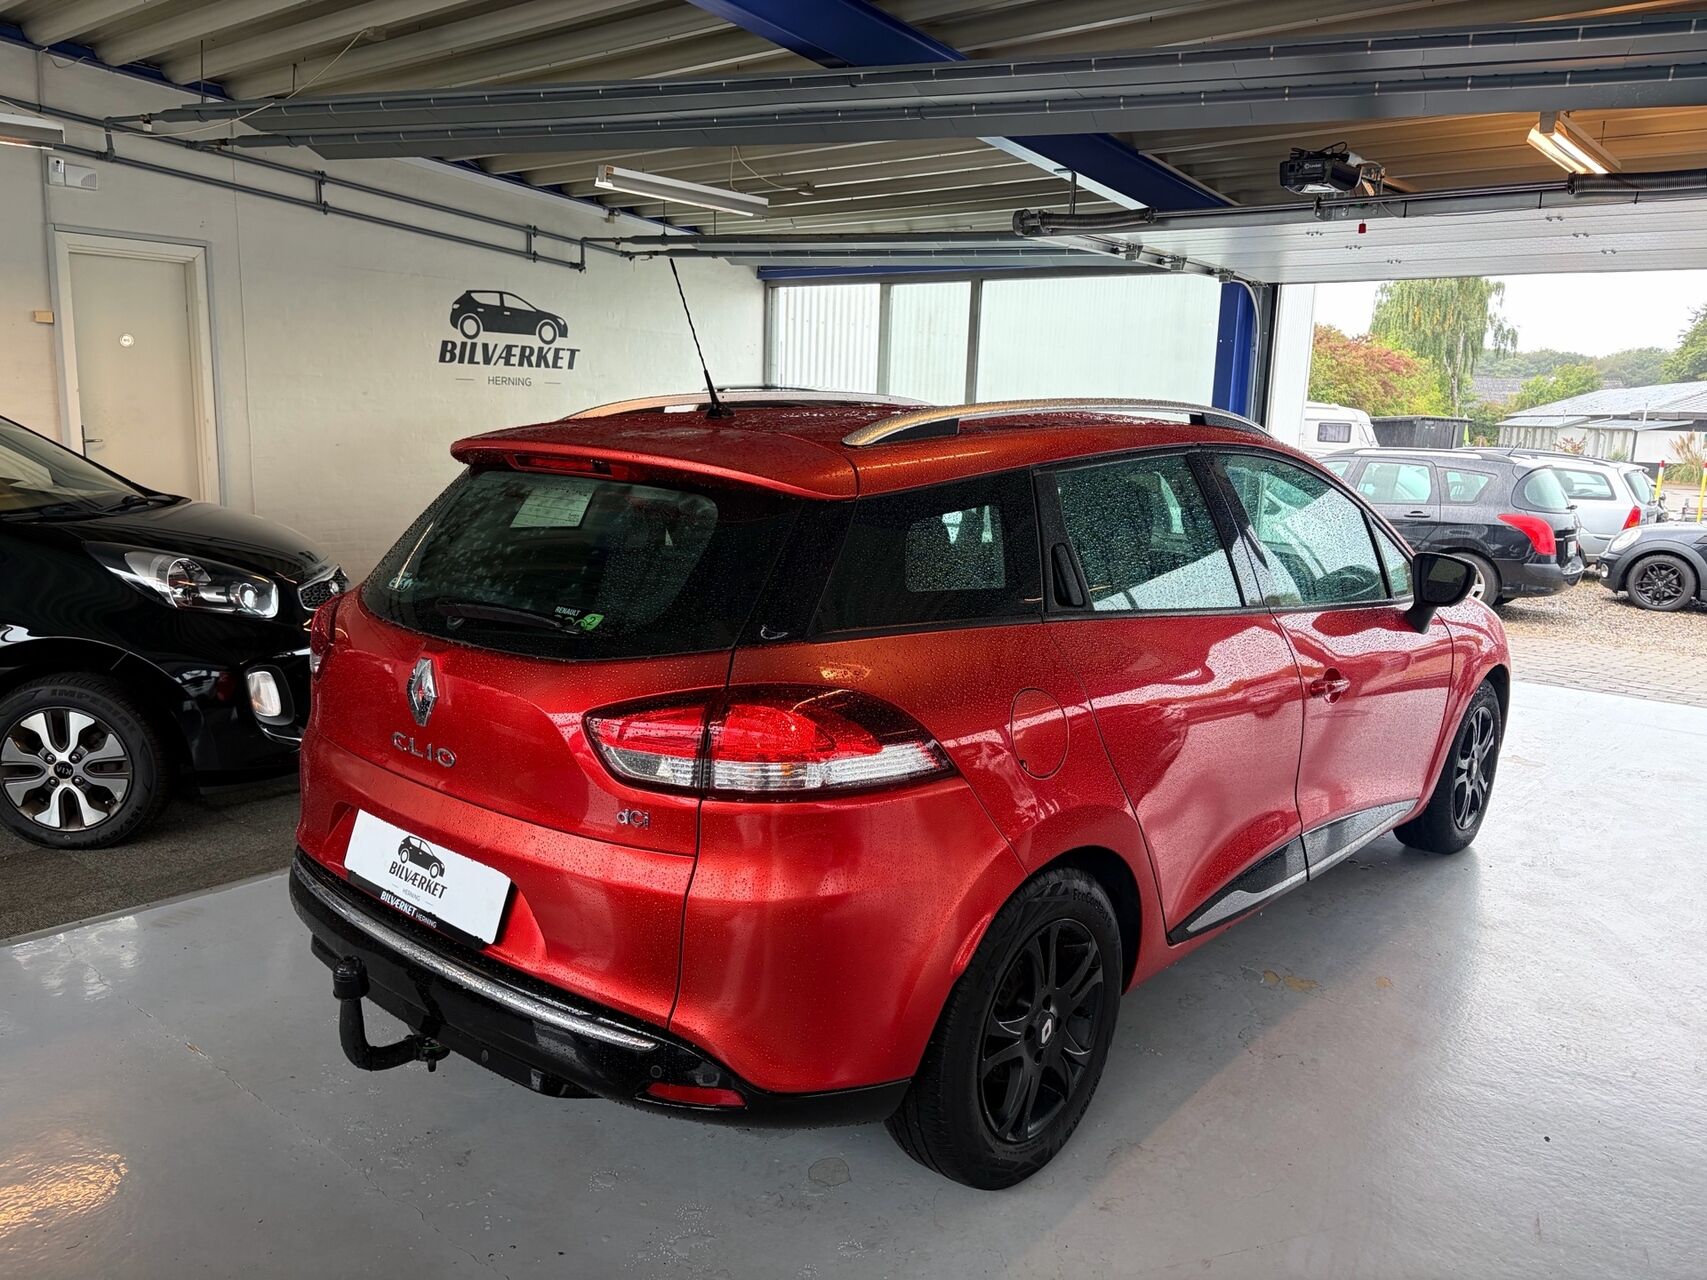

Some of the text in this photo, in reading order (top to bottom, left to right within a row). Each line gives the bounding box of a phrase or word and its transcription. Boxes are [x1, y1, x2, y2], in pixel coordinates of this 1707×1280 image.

[438, 340, 581, 370] BILVÆRKET
[487, 376, 532, 387] HERNING
[554, 605, 582, 617] RENAULT
[391, 732, 457, 768] CLIO
[56, 764, 73, 776] KIA
[616, 808, 649, 830] dCi
[388, 861, 447, 899] BILVÆRKET
[380, 891, 418, 917] BILVÆRKET
[415, 911, 437, 928] HERNING
